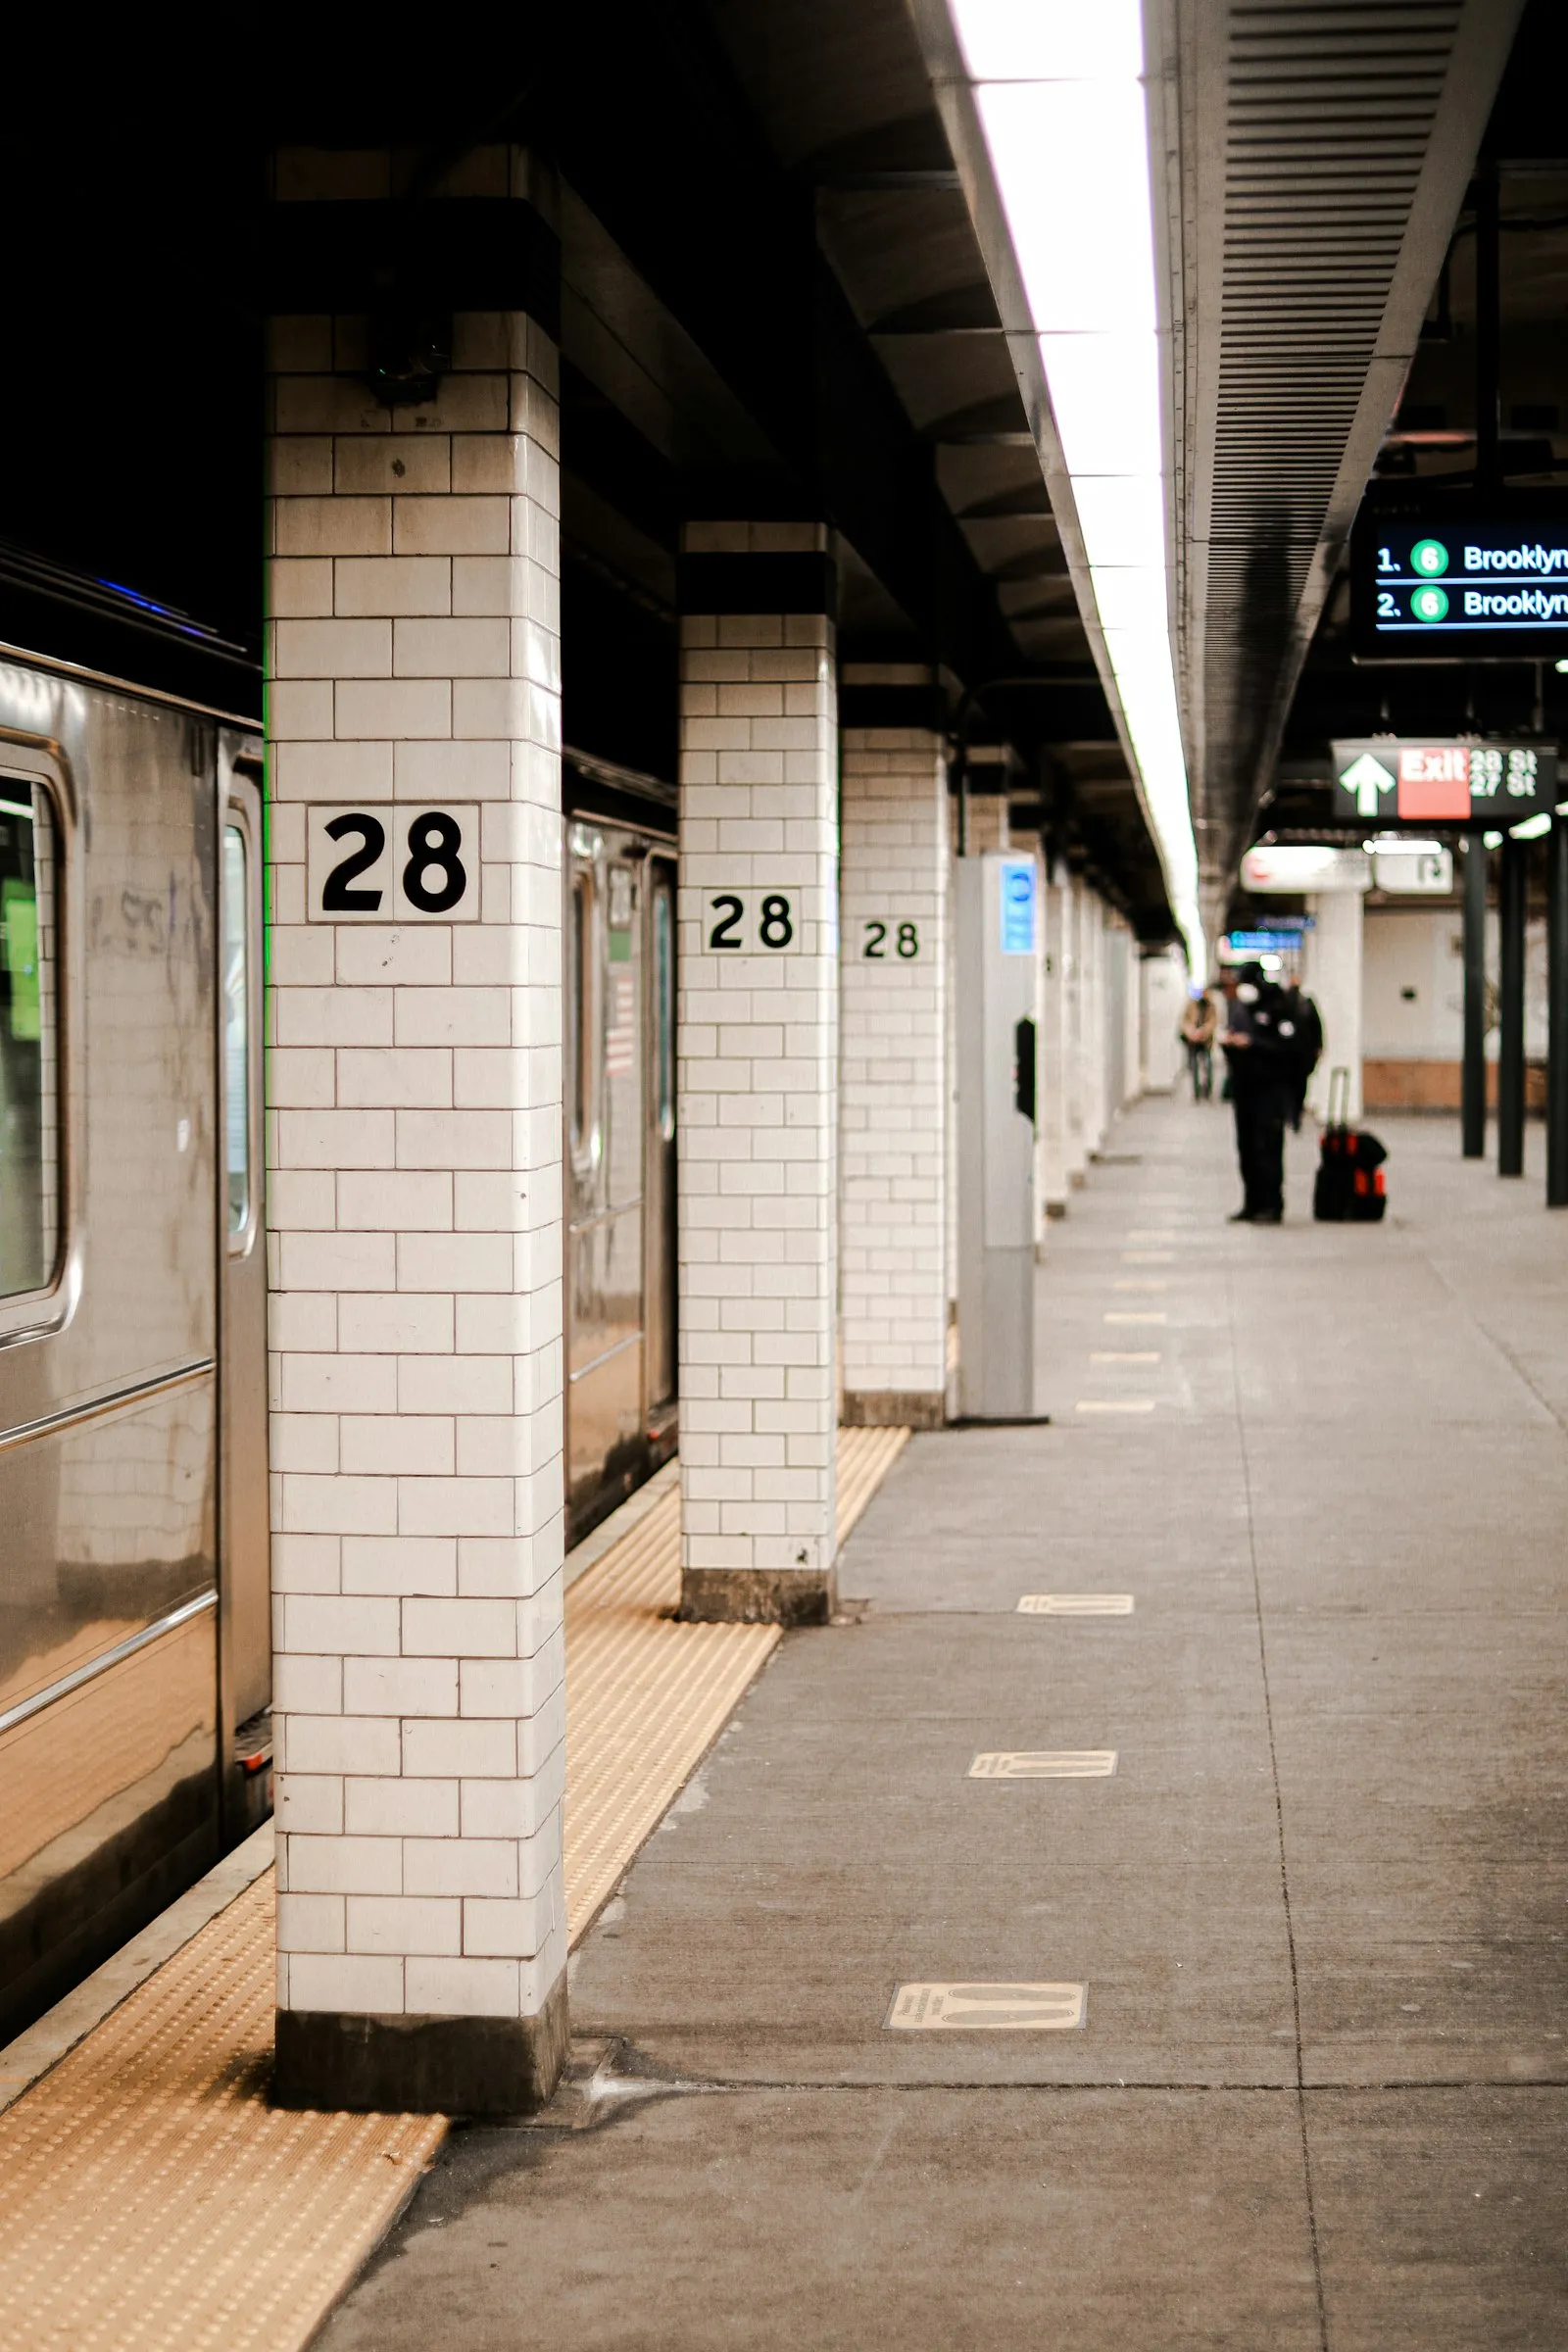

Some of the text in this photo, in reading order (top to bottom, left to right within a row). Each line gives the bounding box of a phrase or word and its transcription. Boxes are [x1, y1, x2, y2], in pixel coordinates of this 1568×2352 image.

[1377, 544, 1568, 575] 1. 6 Brooklyn
[1377, 589, 1568, 620] 2. 6 Brooklyn
[1400, 749, 1467, 782] Exit
[1508, 749, 1538, 774] St
[1469, 772, 1537, 797] 27 St
[321, 811, 467, 913] 28
[709, 894, 794, 950] 28
[862, 921, 920, 959] 28
